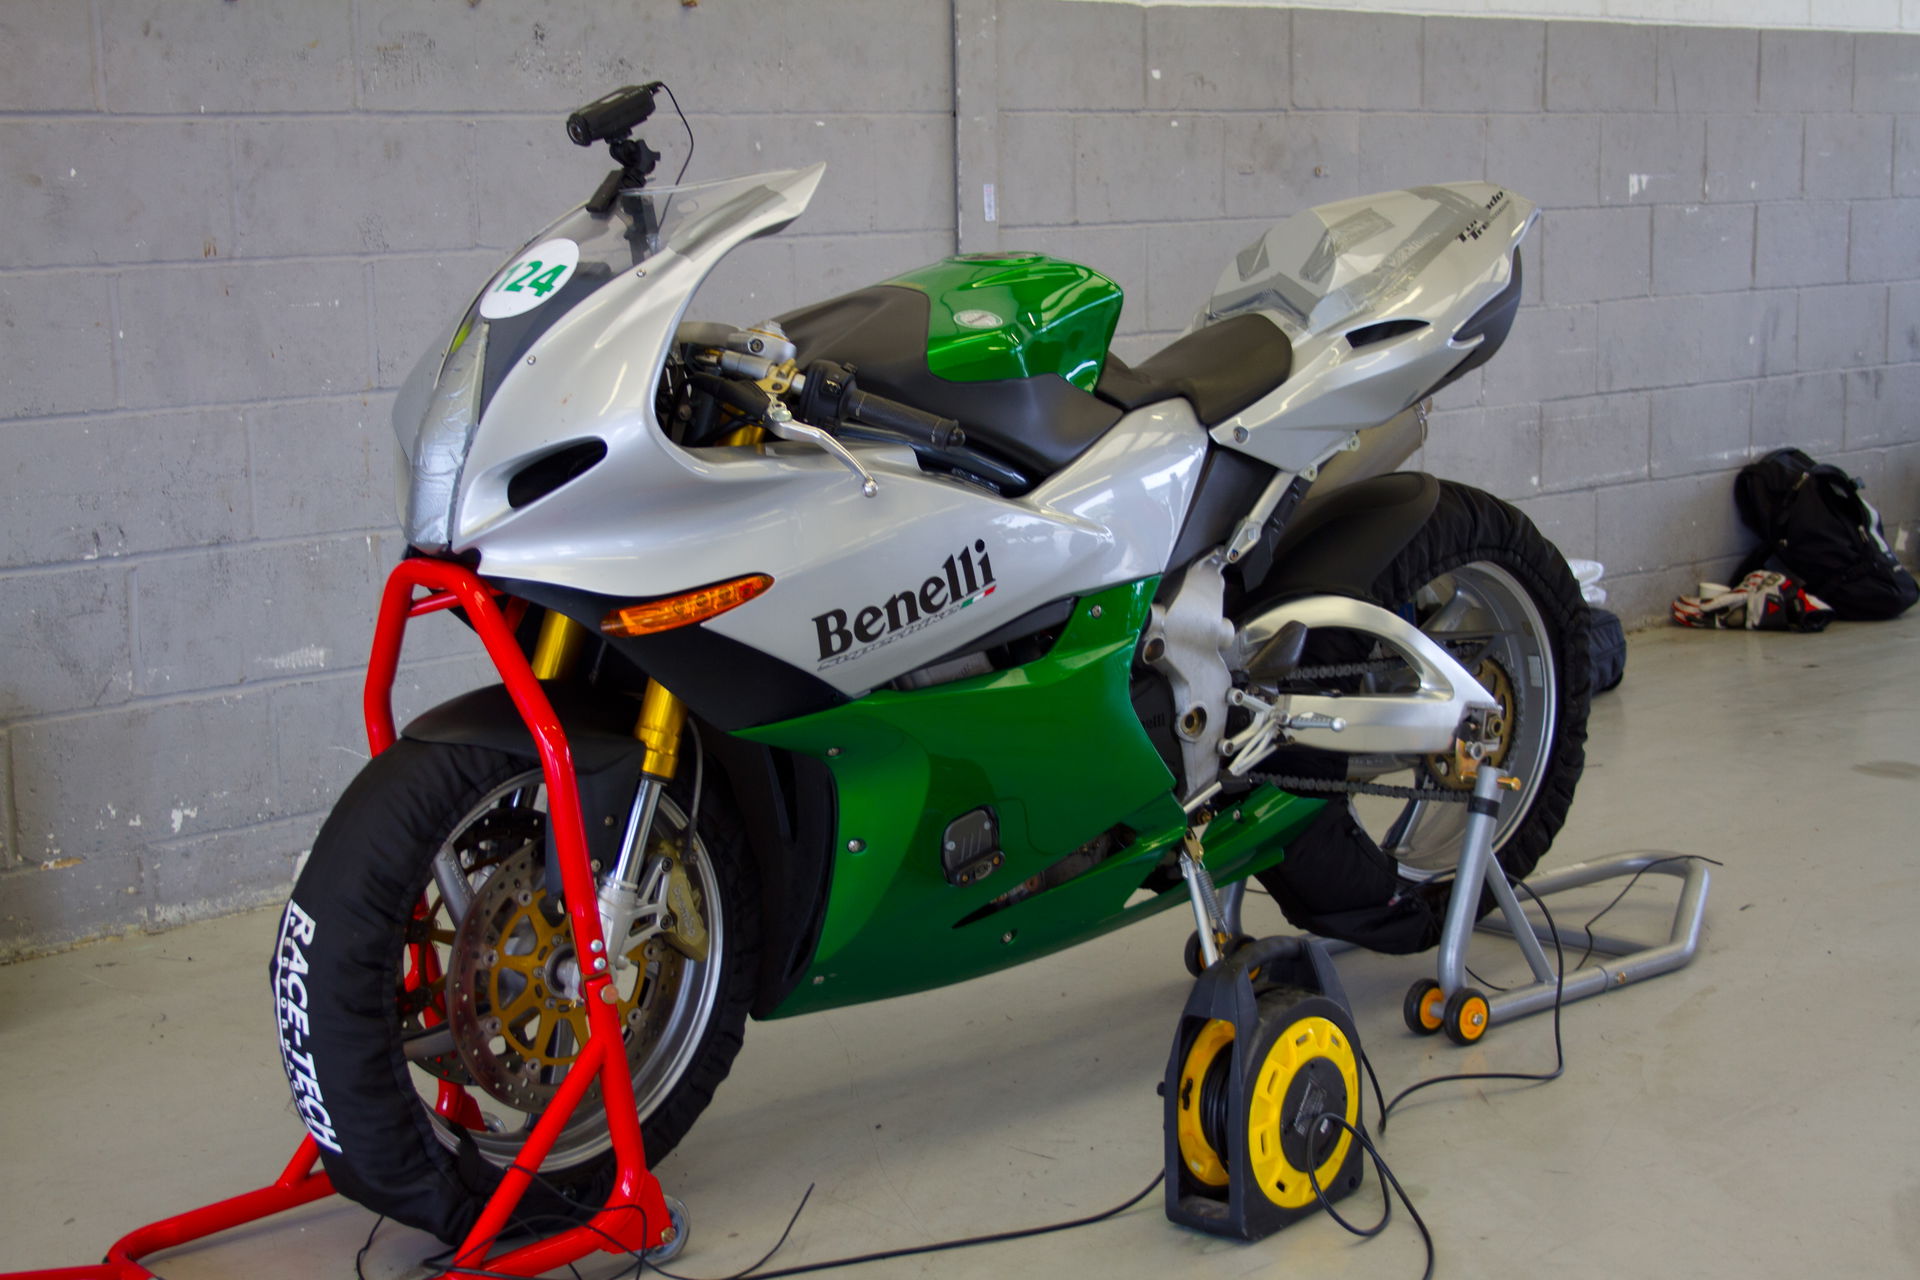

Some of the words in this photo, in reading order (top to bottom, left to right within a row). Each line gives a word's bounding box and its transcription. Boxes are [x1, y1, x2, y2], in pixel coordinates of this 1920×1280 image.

[494, 260, 568, 297] 124
[812, 538, 996, 661] Benelli
[286, 902, 342, 1153] RACE-TECH
